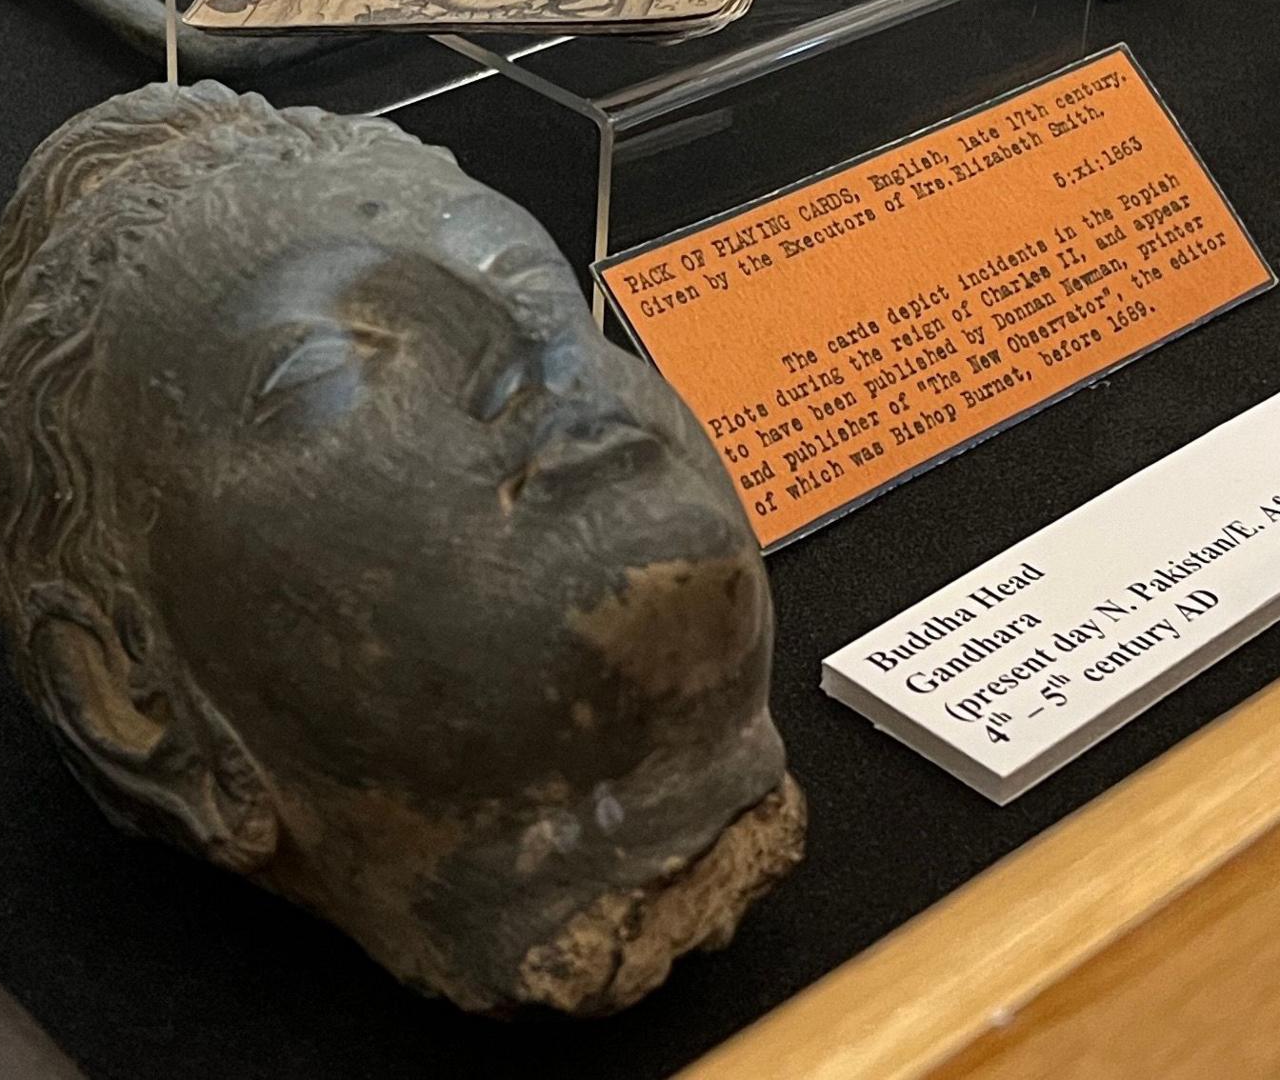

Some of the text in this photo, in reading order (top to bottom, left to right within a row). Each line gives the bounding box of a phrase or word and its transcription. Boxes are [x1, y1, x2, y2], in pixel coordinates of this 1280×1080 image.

[622, 70, 1127, 294] PACK OF PLAYING CARDS, English, late 17th century.
[639, 284, 700, 318] Given
[701, 270, 729, 290] by
[737, 252, 773, 276] the
[777, 207, 876, 259] Executors
[883, 190, 905, 212] of
[1046, 104, 1105, 138] Smith.
[780, 172, 1180, 374] The cards depict incidents in the Popish
[707, 193, 1191, 438] Plots during the reign of Charles II, and appear
[724, 442, 749, 463] to
[753, 416, 804, 448] have
[806, 390, 857, 421] been
[862, 336, 959, 400] published
[959, 324, 985, 345] by
[1057, 257, 1128, 297] Newman,
[1135, 214, 1204, 261] printer
[739, 459, 776, 490] and
[781, 409, 880, 473] publisher
[887, 390, 910, 415] of
[964, 348, 1002, 375] New
[1129, 266, 1163, 289] the
[1168, 231, 1226, 270] editor
[754, 299, 1156, 516] of which was Bishop Burnet, before 1689.
[862, 561, 1046, 673] Buddha Head
[904, 612, 1042, 694] Gandhara
[943, 646, 1058, 723] (present
[1050, 617, 1106, 653] day
[1092, 597, 1138, 623] N.
[1124, 519, 1266, 602] Pakistan/E.
[984, 711, 1013, 744] 4th
[1038, 673, 1072, 707] 5th
[1082, 617, 1181, 682] century
[1173, 588, 1219, 623] AD
